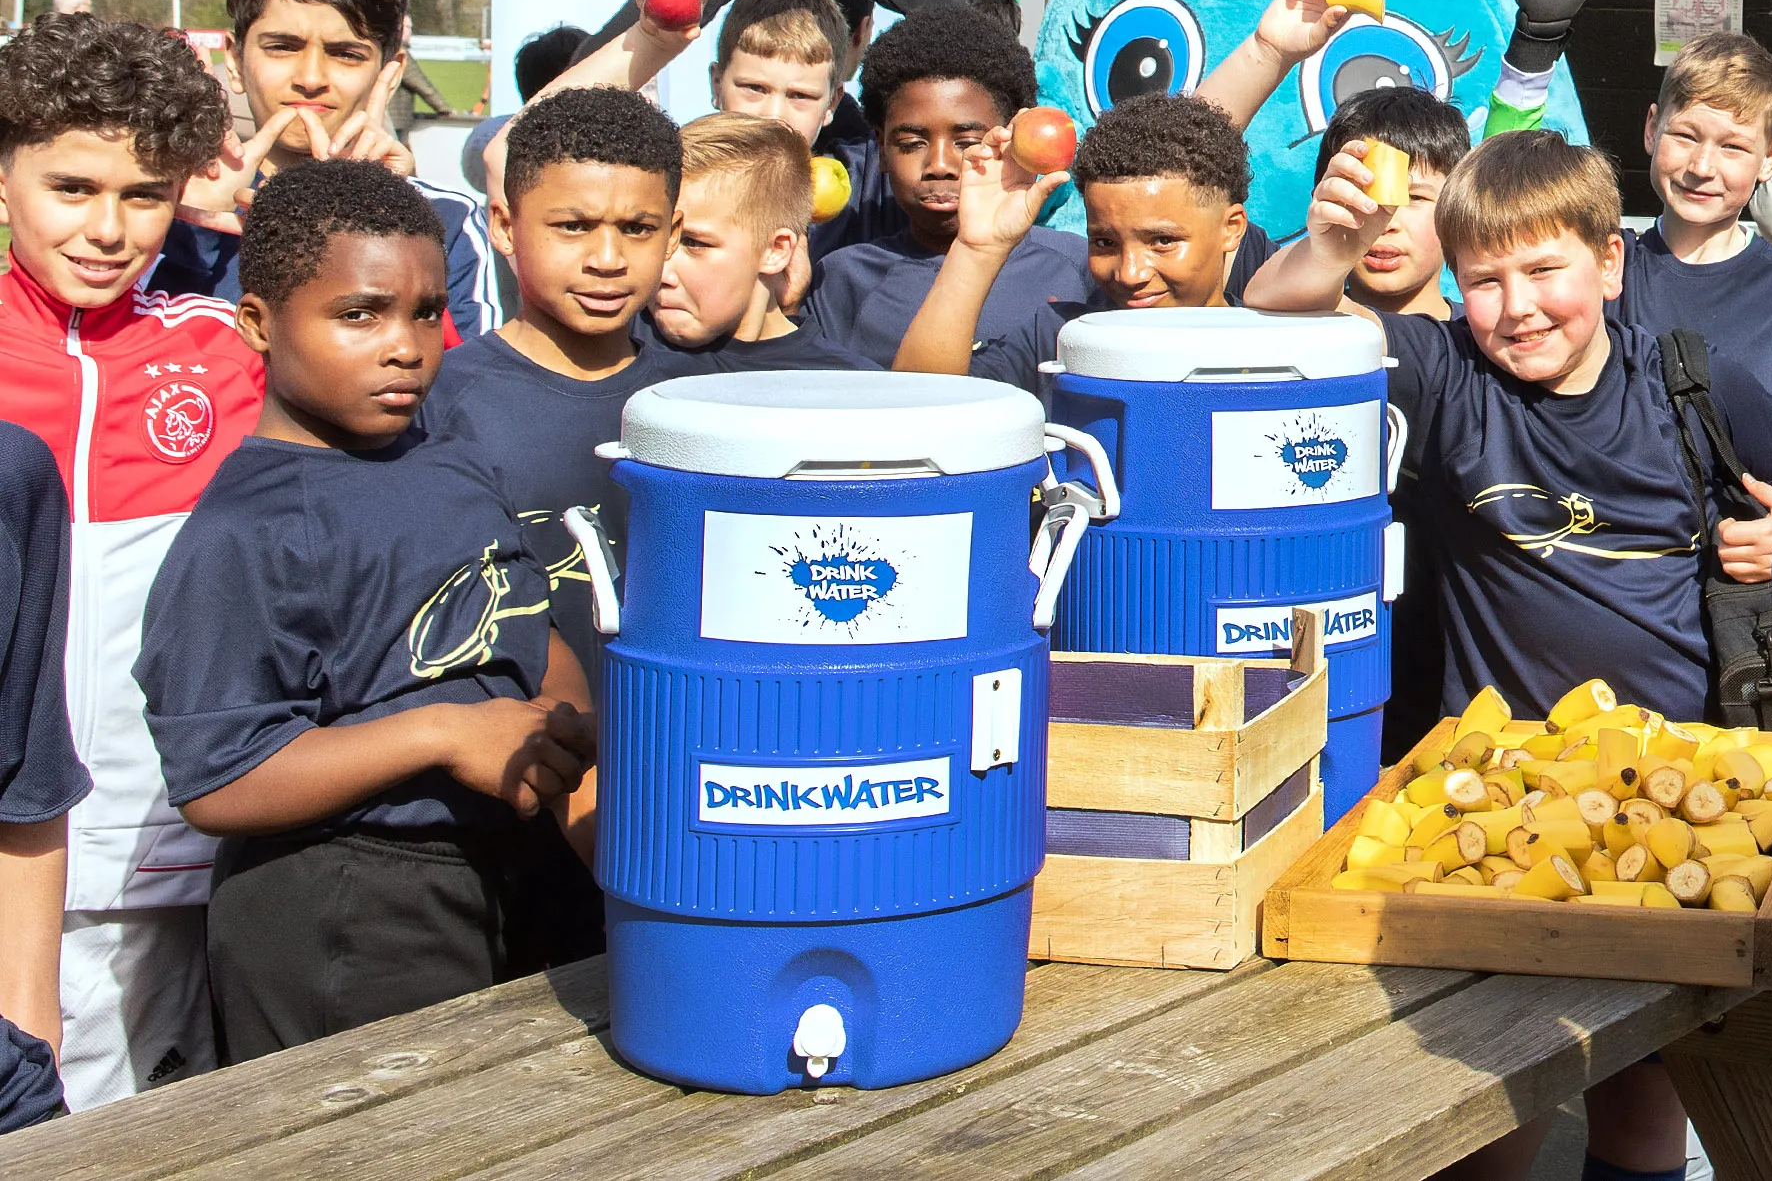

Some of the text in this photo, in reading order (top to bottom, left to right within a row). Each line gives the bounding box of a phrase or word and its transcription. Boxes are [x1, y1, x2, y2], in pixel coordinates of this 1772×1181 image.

[145, 383, 180, 419] AJAX
[1294, 443, 1337, 458] DRINK
[1293, 457, 1339, 474] WATER
[810, 562, 879, 581] DRINK
[808, 579, 880, 601] WATER
[704, 773, 945, 811] DRINKWATER
